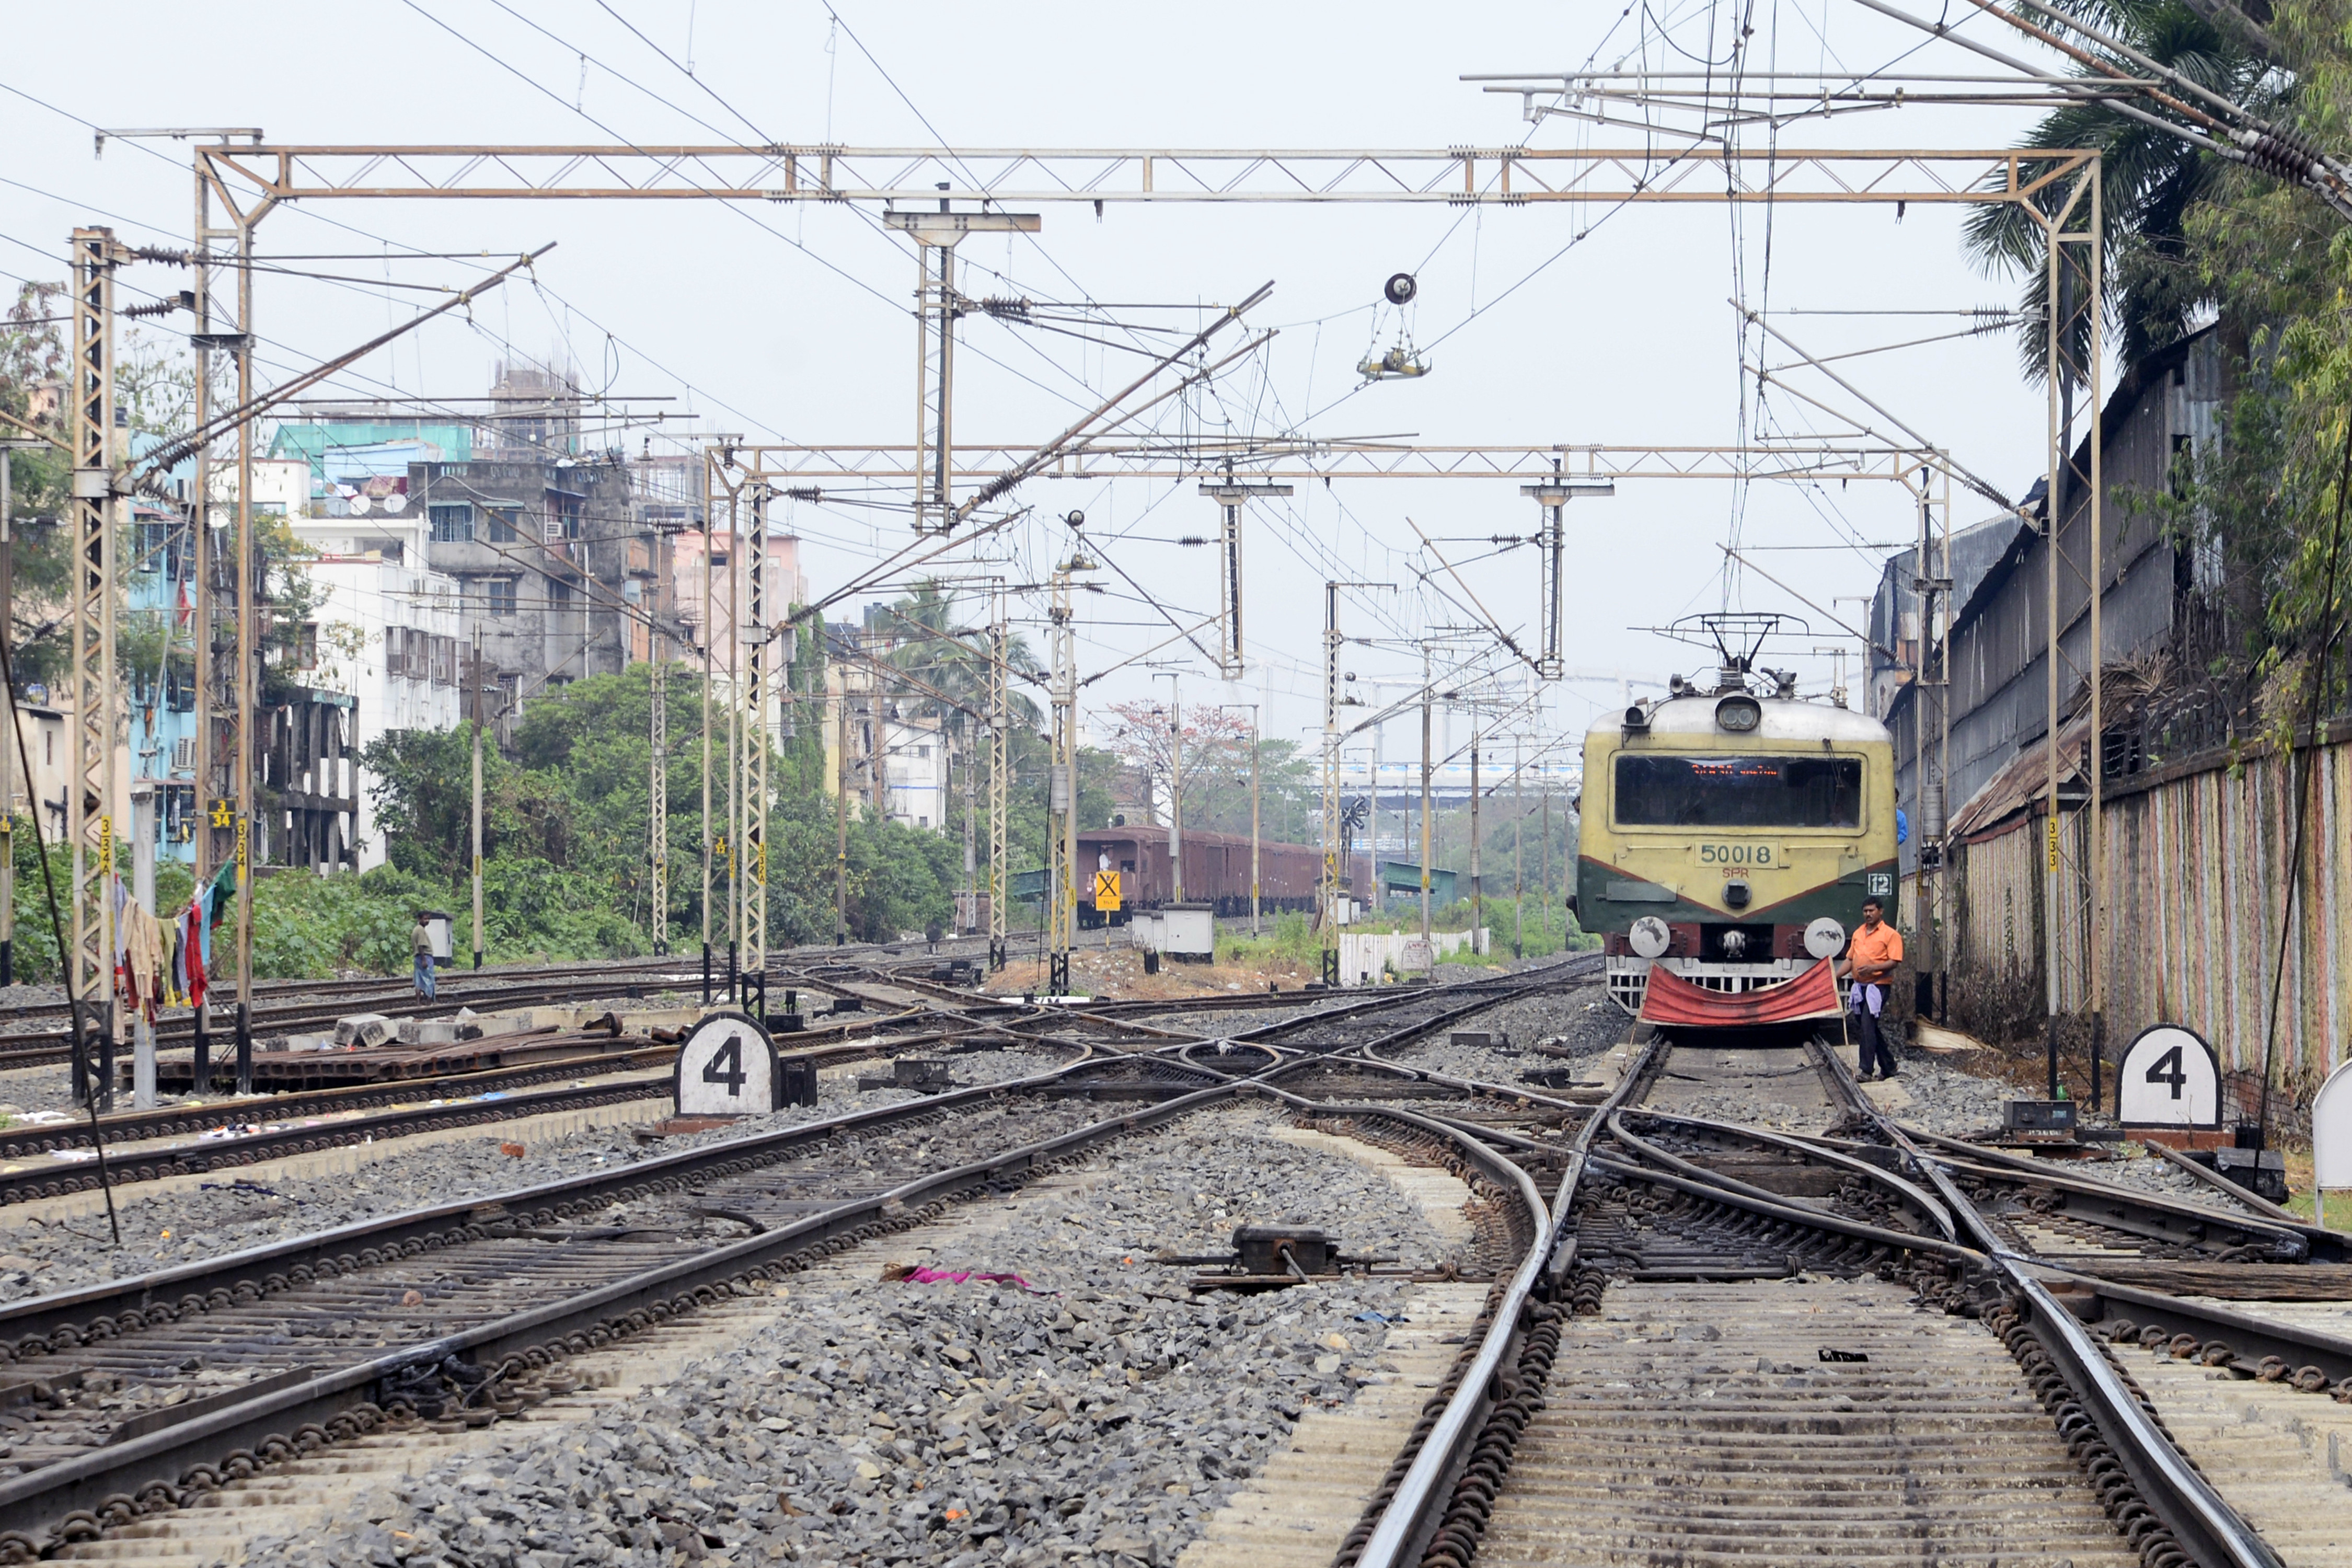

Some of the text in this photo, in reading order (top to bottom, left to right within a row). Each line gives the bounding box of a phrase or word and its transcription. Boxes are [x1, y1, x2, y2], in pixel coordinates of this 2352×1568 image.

[217, 800, 226, 812] 3
[213, 814, 230, 827] 34
[1701, 844, 1771, 863] 50018
[1723, 867, 1749, 878] SPR
[1872, 876, 1888, 893] 12
[702, 1036, 747, 1096] 4
[2146, 1045, 2187, 1100] 4
